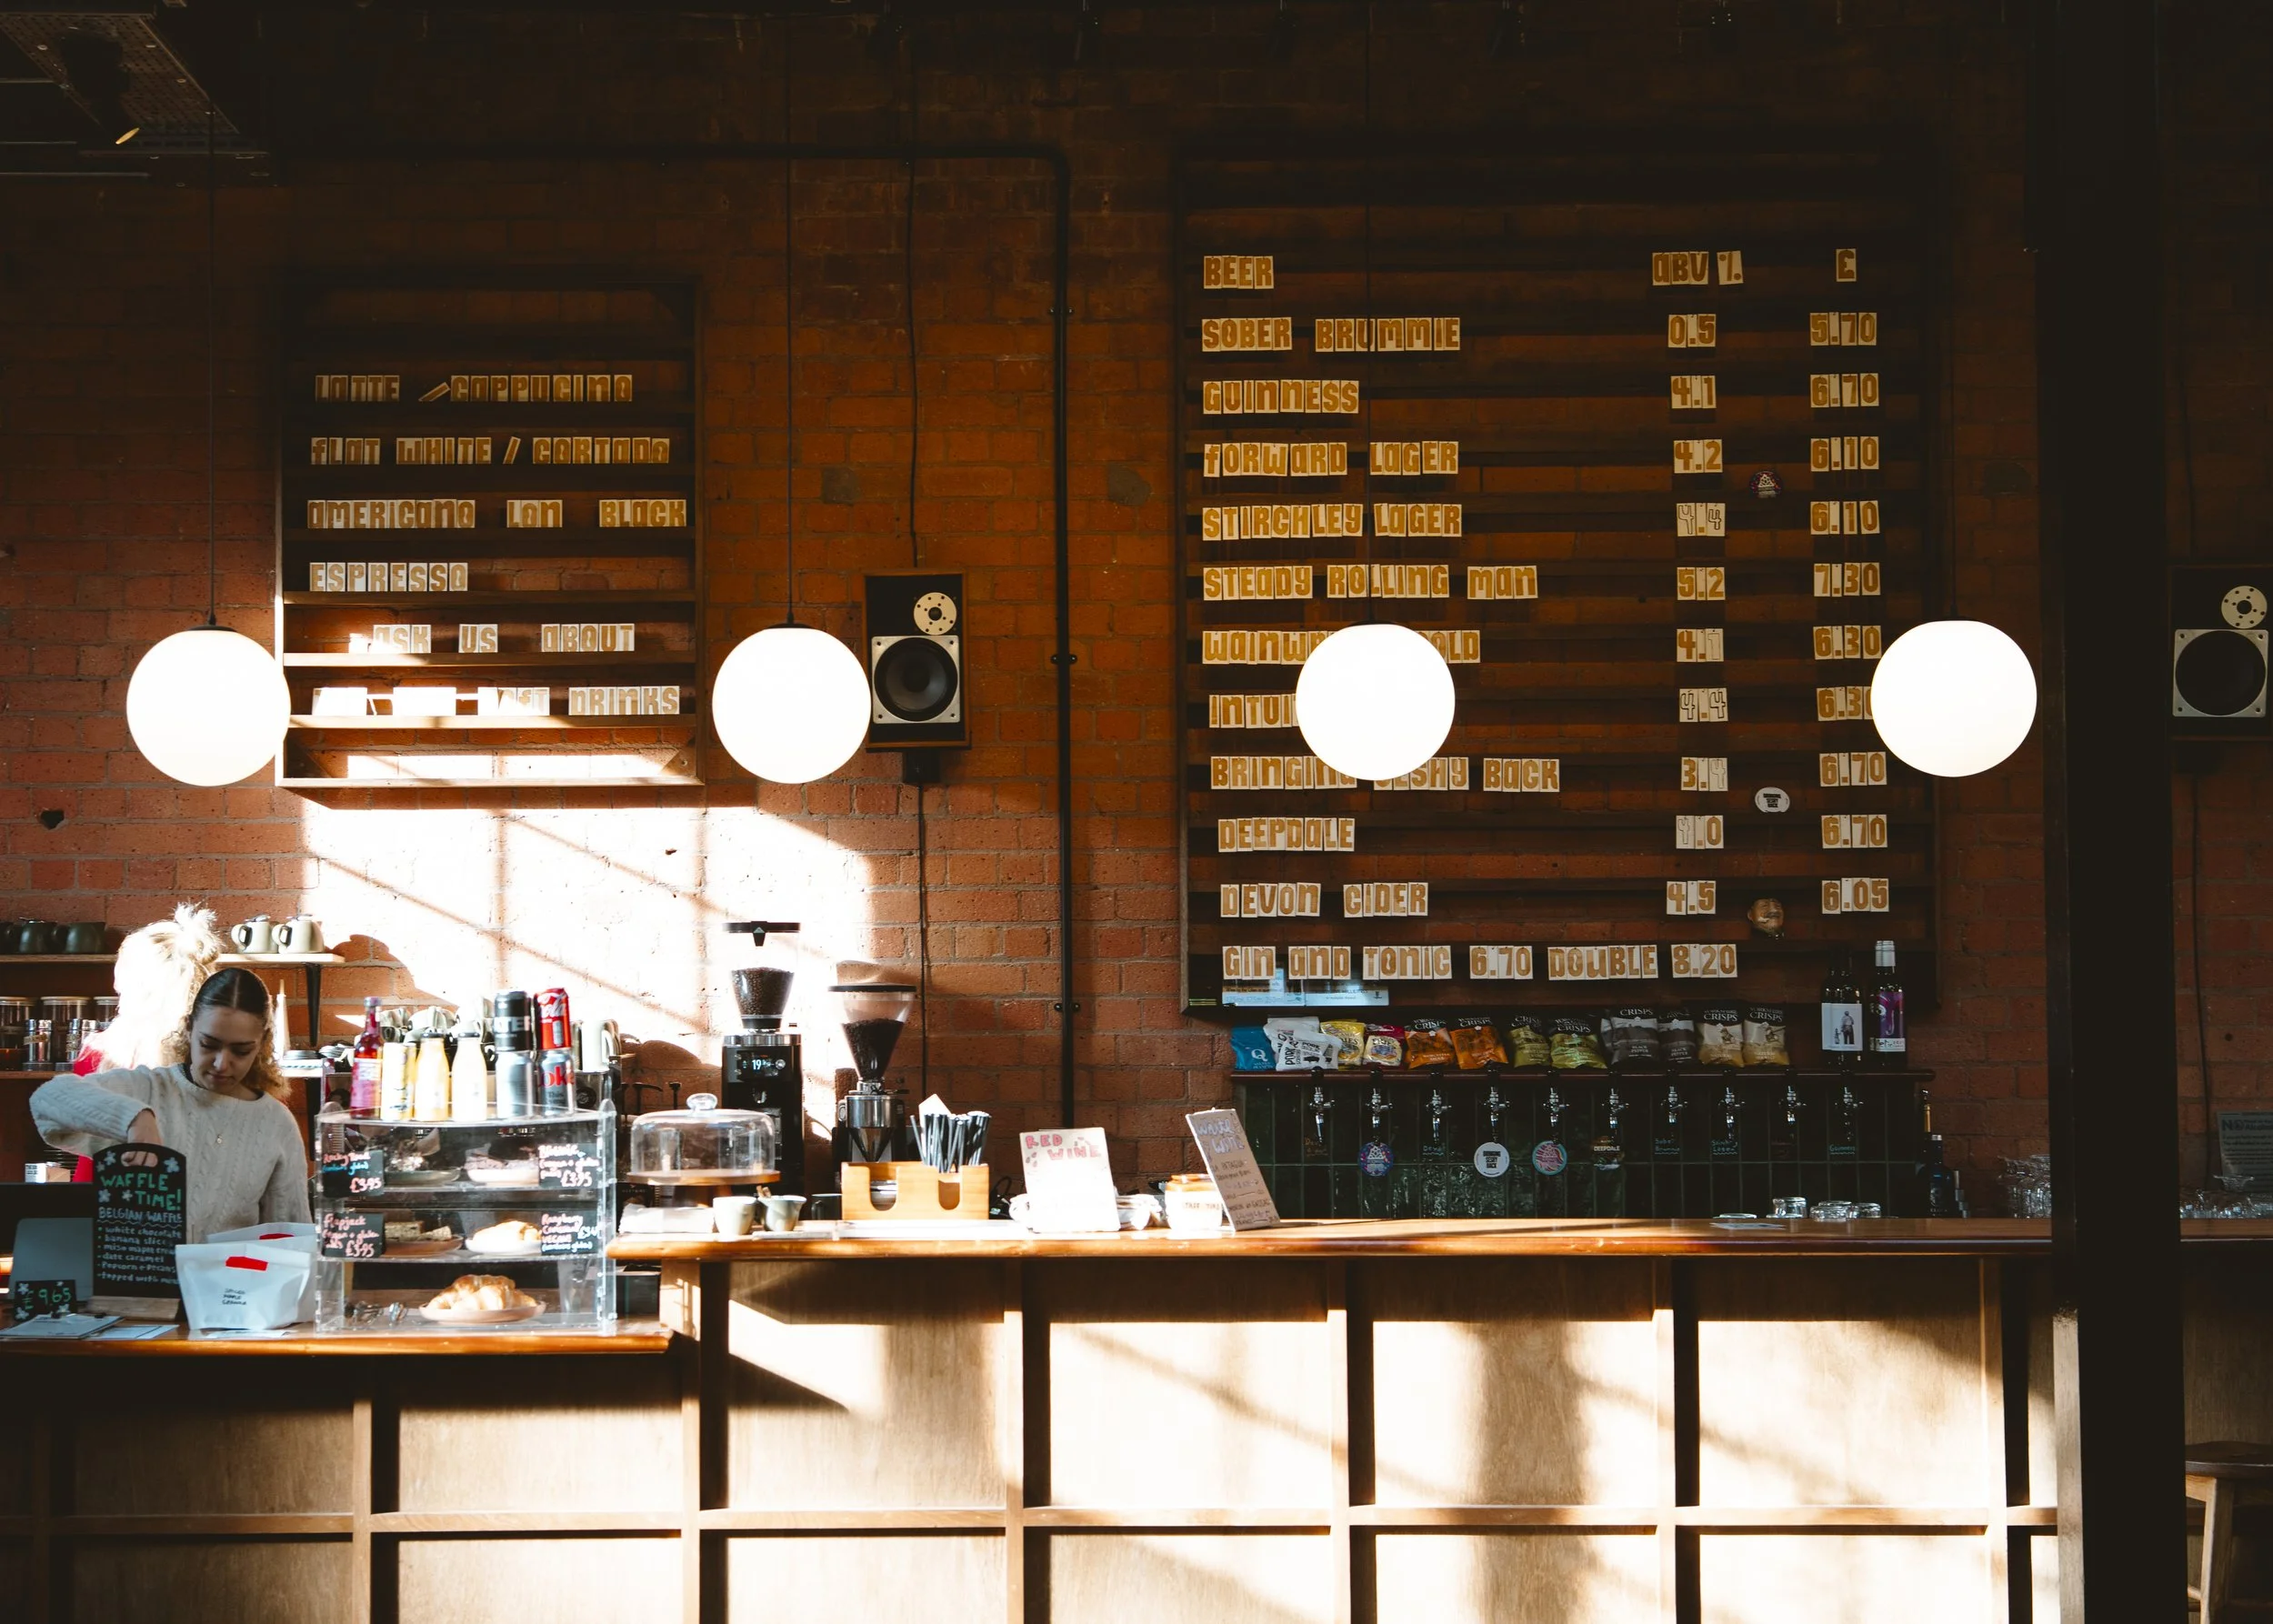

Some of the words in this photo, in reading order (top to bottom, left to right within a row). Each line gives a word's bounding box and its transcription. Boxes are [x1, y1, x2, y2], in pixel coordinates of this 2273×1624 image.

[1206, 258, 1272, 286] BEER
[1653, 253, 1707, 283] ABV
[1719, 252, 1741, 281] %
[1837, 250, 1855, 279] £
[1205, 320, 1290, 349] SOBER
[1317, 320, 1458, 349] BRUMMIE
[1669, 316, 1715, 346] 0.5
[1811, 315, 1875, 344] 5.70
[317, 376, 398, 401] LATTE
[452, 376, 631, 401] CAPPUCINO
[1205, 383, 1357, 412] GUINNESS
[1672, 376, 1714, 406] 4.1
[1812, 375, 1877, 406] 6.70
[313, 439, 379, 464] FLAT
[397, 439, 490, 464] WHITE
[534, 438, 668, 463] CORTADO
[1205, 445, 1346, 475] FORWARD
[1371, 443, 1457, 473] LAGER
[1675, 441, 1721, 470] 4.2
[1812, 438, 1877, 469] 6.10
[309, 501, 474, 527] AMERICANO
[508, 502, 561, 527] LON
[600, 501, 685, 526] BLACK
[1205, 506, 1362, 538] STIRCHLEY
[1377, 506, 1461, 536] LAGER
[1677, 505, 1722, 535] 4.4
[1812, 502, 1878, 533] 6.10
[311, 565, 466, 591] ESPRESSO
[1205, 567, 1311, 598] STEADY
[1328, 566, 1448, 596] ROLLING
[1469, 566, 1537, 597] MAN
[1678, 569, 1724, 598] 5.2
[1816, 564, 1879, 595] 7.30
[460, 625, 496, 652] US
[543, 625, 634, 651] ABOUT
[1418, 632, 1478, 661] OLD
[1677, 631, 1722, 660] 4.1
[1815, 627, 1880, 657] 6.30
[570, 687, 678, 714] DRINKS
[1680, 690, 1727, 720] 4.4
[1376, 759, 1467, 787] SHY
[1485, 761, 1557, 789] BACK
[1683, 759, 1727, 789] 3.4
[1821, 754, 1886, 785] 6.70
[1220, 820, 1353, 849] DEEPDALE
[1823, 817, 1887, 846] 6.70
[1222, 886, 1318, 915] DEVON
[1346, 885, 1427, 914] CIDER
[1667, 883, 1715, 912] 4.5
[1823, 880, 1887, 911] 6.05
[1224, 948, 1274, 977] GIN
[1289, 948, 1349, 977] AND
[1365, 948, 1450, 977] TONIC
[1471, 947, 1531, 977] 6.70
[1549, 947, 1656, 977] DOUBLE
[1673, 947, 1736, 976] 8.20
[1251, 1049, 1267, 1061] Q
[1026, 1135, 1063, 1149] RED
[1047, 1146, 1102, 1160] WINE
[101, 1173, 168, 1191] WAFFLE
[135, 1188, 182, 1211] TIME!
[98, 1207, 143, 1222] BELGIAN
[105, 1235, 140, 1245] banana
[125, 1255, 164, 1263] caramel
[22, 1288, 72, 1310] £9.65
